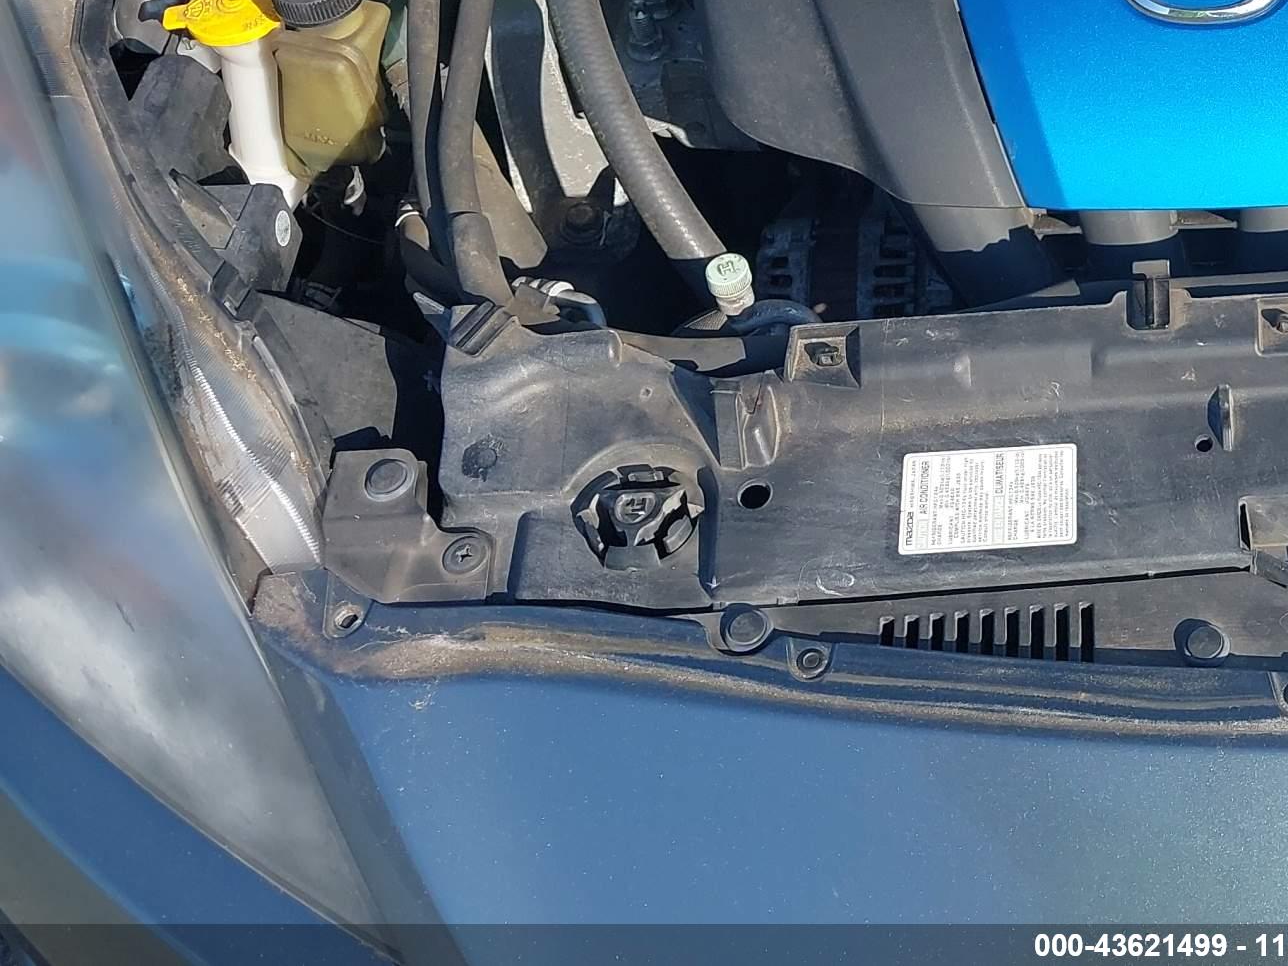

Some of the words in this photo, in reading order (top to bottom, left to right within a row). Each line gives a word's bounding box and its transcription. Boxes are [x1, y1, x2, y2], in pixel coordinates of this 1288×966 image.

[919, 461, 930, 503] CONDITIONER
[994, 453, 1004, 494] CLIMATISEUR
[919, 503, 928, 514] AIR
[905, 511, 914, 546] mazda
